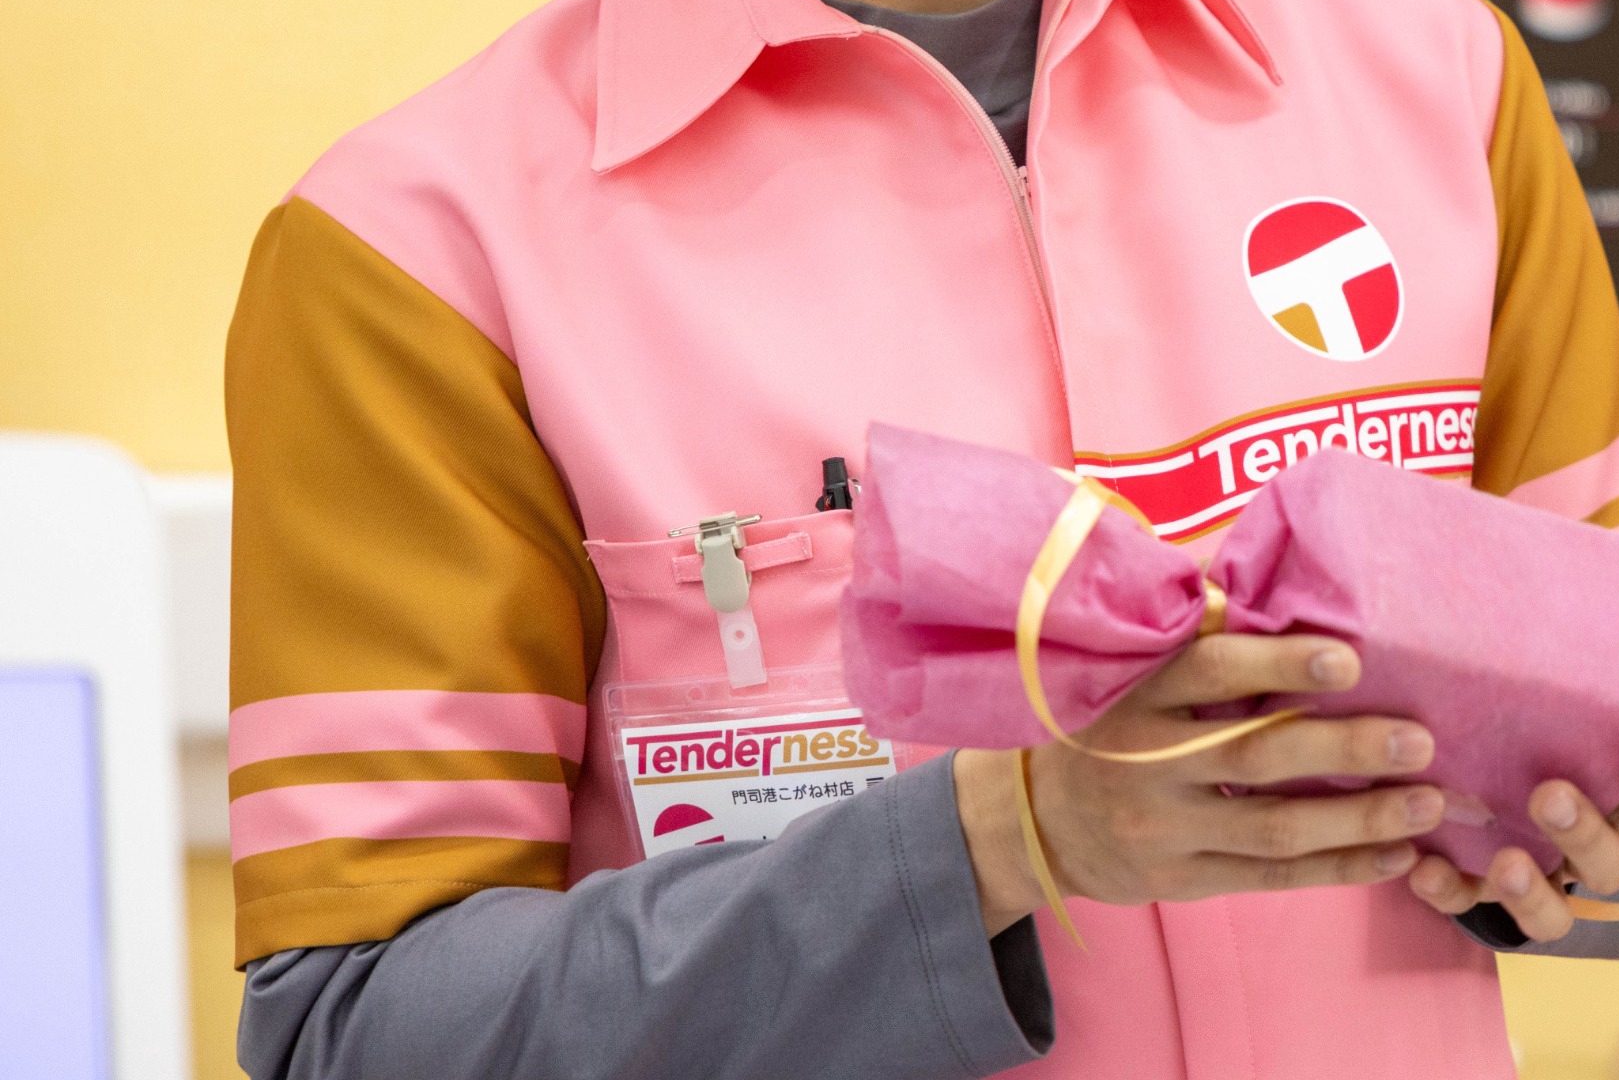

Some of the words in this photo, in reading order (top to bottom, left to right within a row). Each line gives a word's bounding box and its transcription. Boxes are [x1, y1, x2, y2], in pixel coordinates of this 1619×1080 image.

[626, 728, 880, 776] Tenderness
[731, 781, 855, 805] 門司港こがね村店
